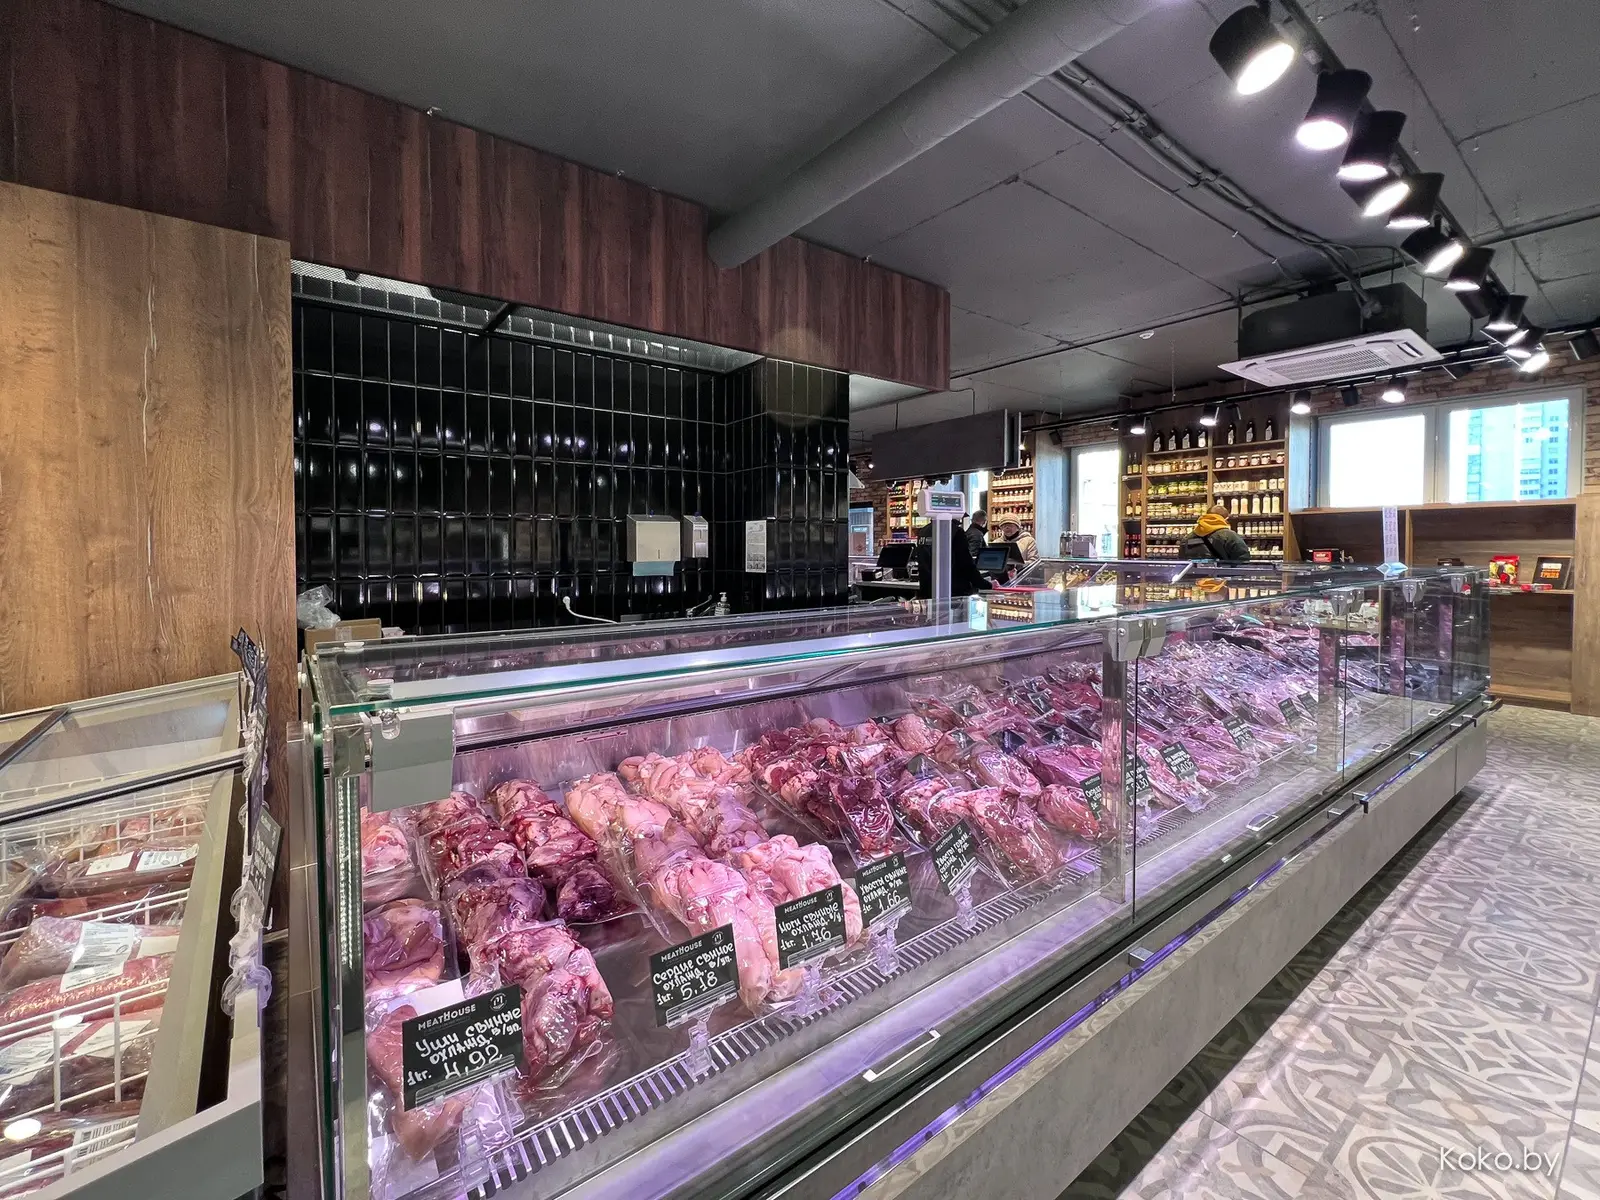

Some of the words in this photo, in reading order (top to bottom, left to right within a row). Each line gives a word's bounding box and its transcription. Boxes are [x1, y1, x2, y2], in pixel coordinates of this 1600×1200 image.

[860, 877, 884, 895] Хвосты
[779, 918, 801, 934] Ноги
[803, 902, 838, 922] свиные
[784, 896, 818, 914] MEATHOUSE
[653, 960, 694, 985] Сердце
[696, 942, 734, 966] свиное
[661, 940, 702, 962] MEATHOUSE
[418, 1004, 476, 1030] MEATHOUSE
[416, 1032, 460, 1058] Уши
[465, 1008, 522, 1037] свиные
[444, 1044, 502, 1080] 4,92
